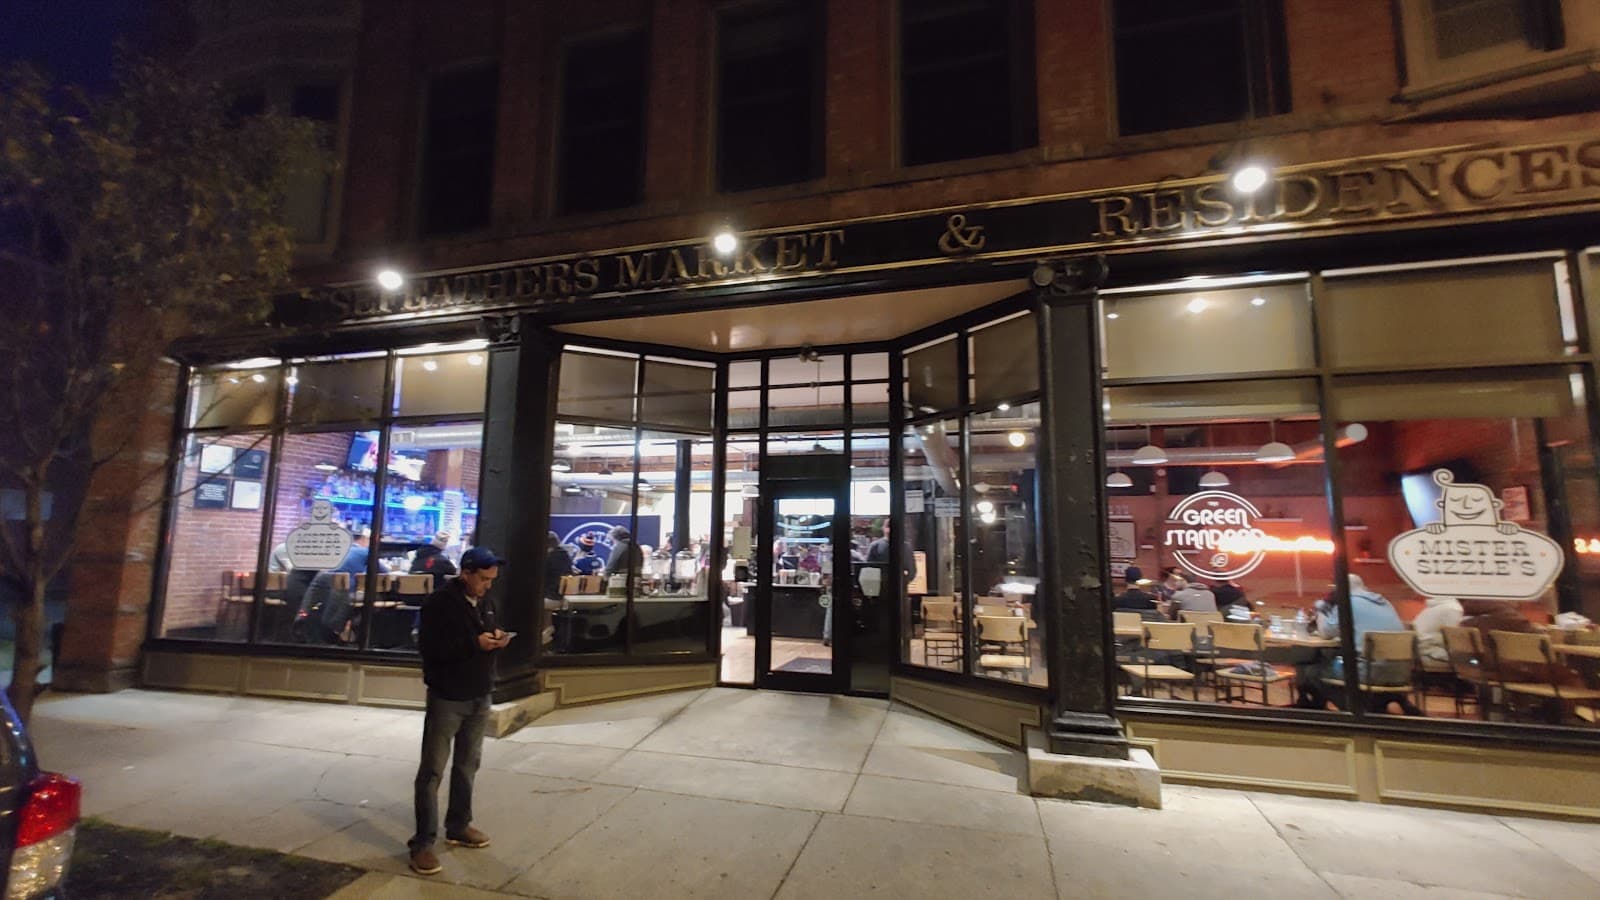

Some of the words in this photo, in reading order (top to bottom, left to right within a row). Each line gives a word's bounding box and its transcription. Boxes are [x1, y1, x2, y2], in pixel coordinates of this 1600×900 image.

[615, 228, 846, 290] MARKET
[936, 212, 987, 255] &
[1088, 139, 1600, 236] RESIDENCES
[1182, 508, 1252, 529] GREEN
[1418, 540, 1531, 557] MISTER
[1416, 559, 1537, 577] SIZZLE'S
